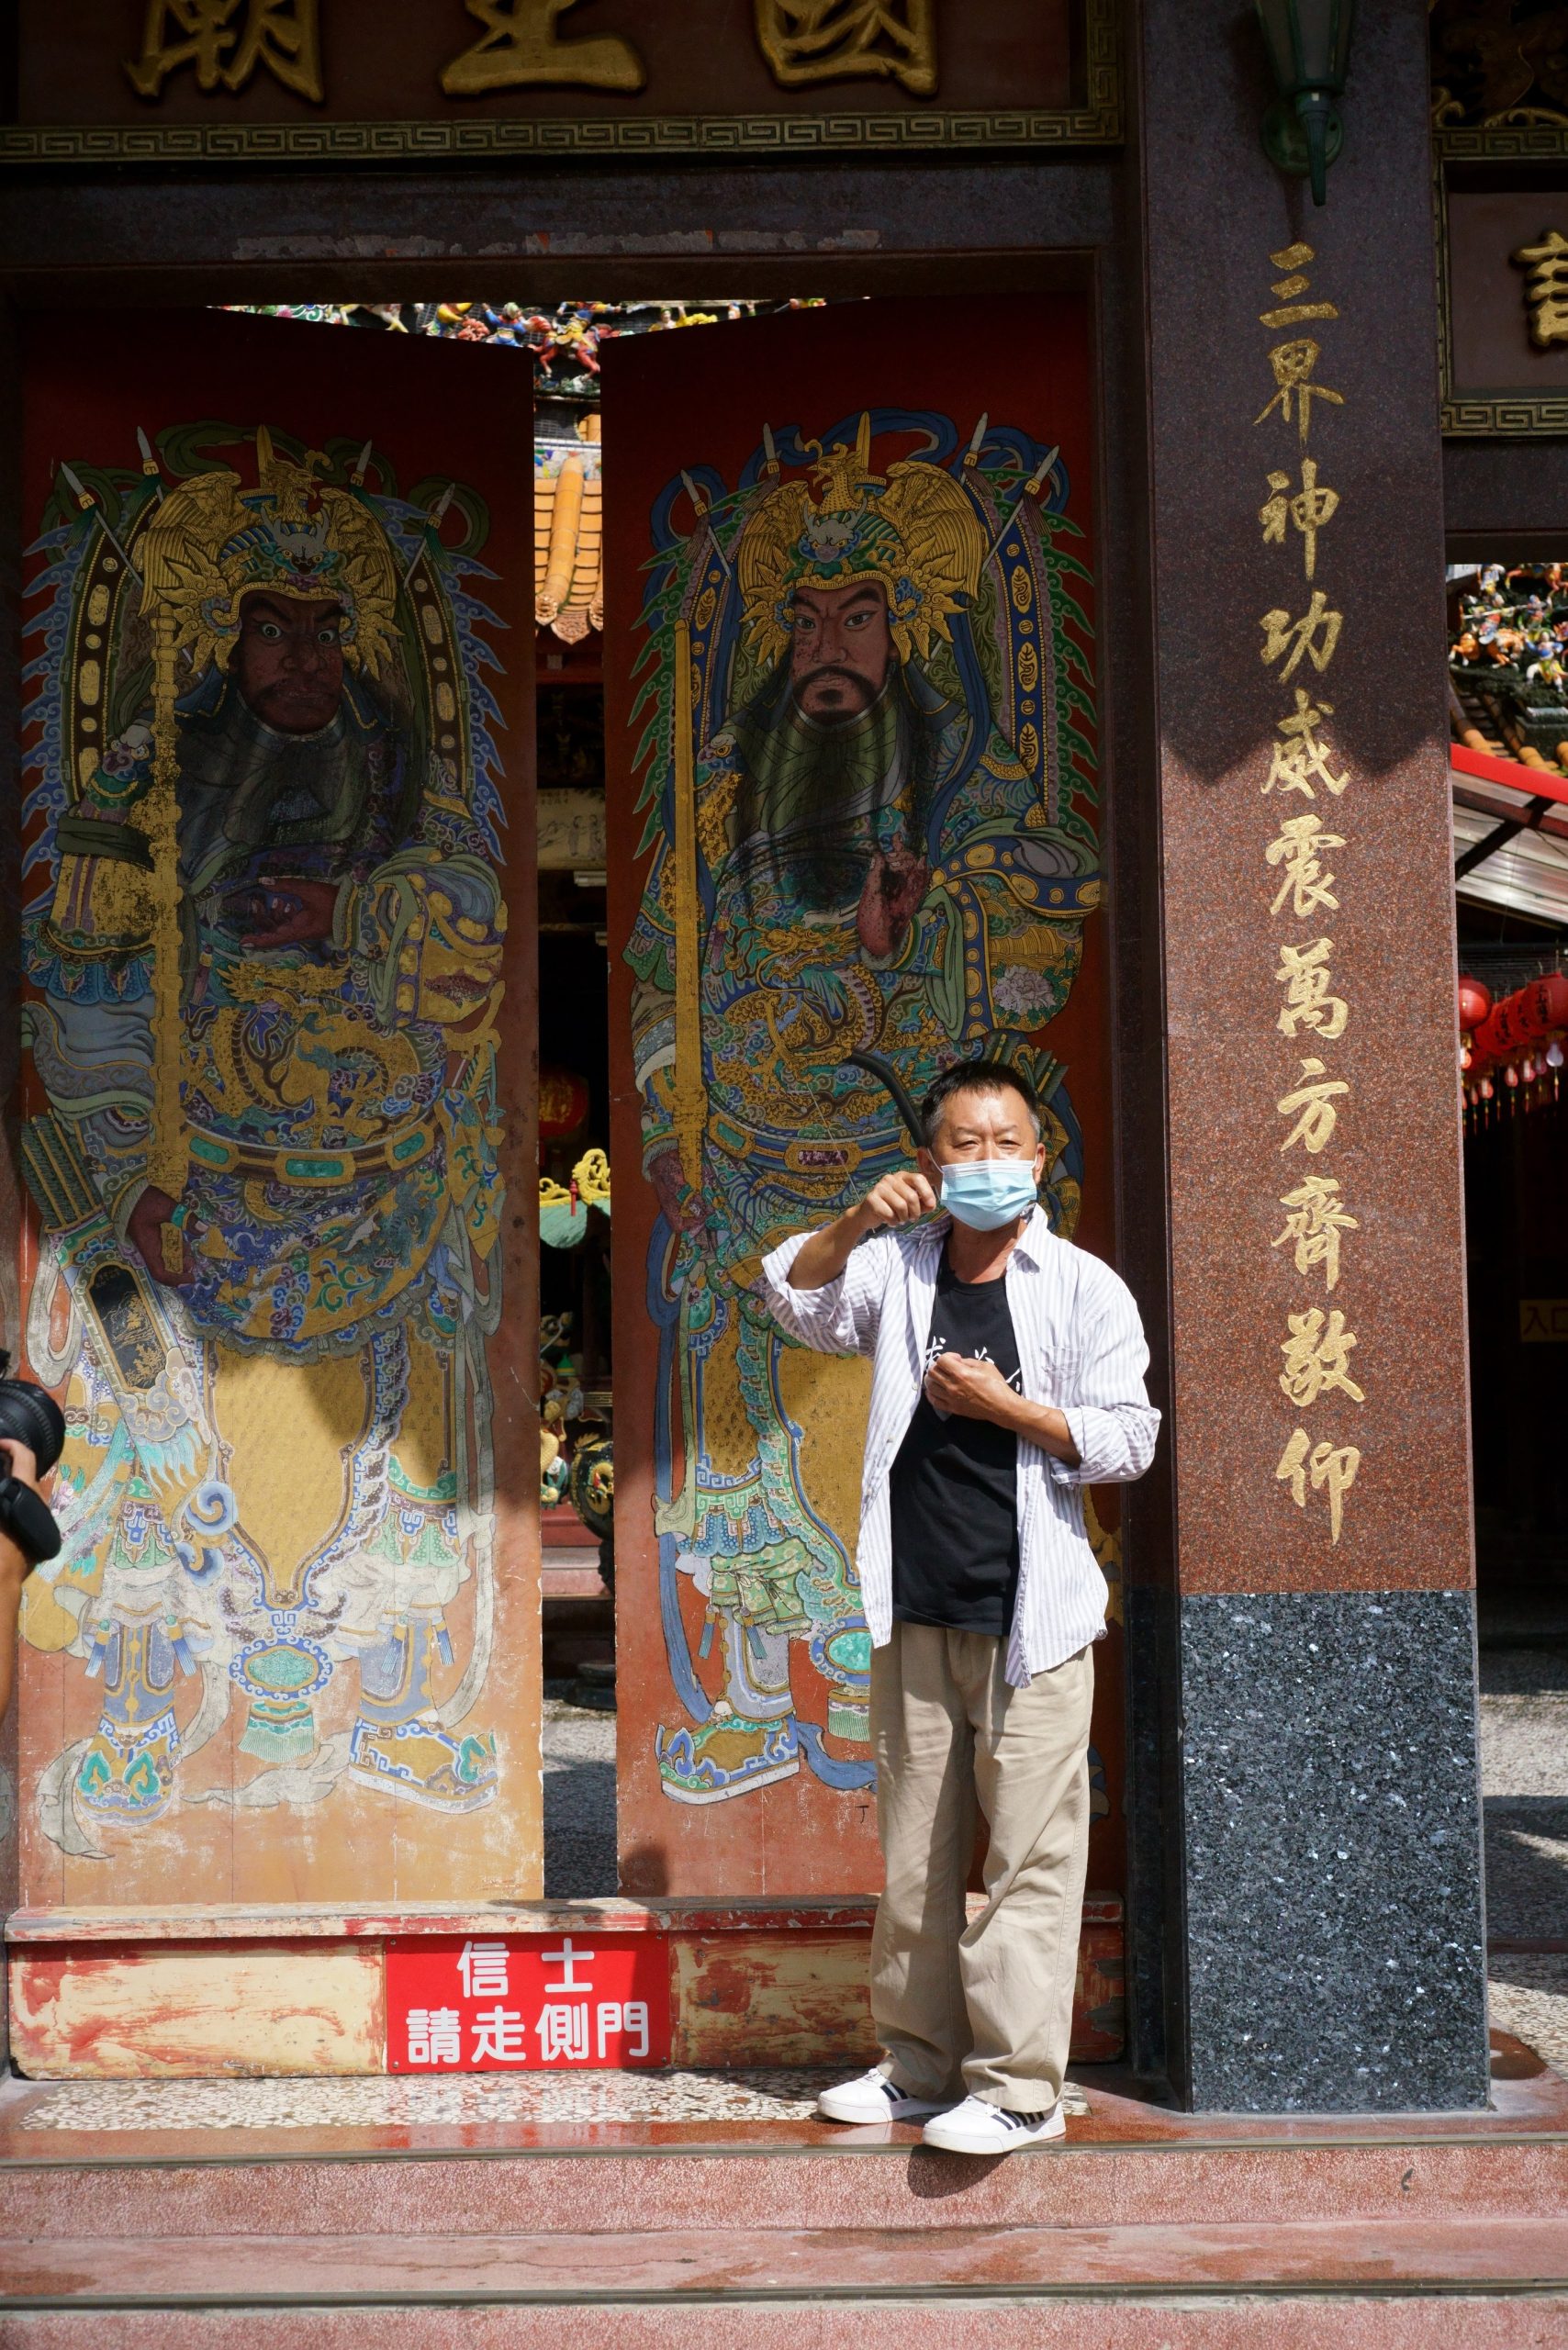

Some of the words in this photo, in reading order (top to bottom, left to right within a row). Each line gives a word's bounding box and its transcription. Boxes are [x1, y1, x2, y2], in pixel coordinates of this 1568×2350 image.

[1253, 241, 1366, 1545] 三界神功威震萬方齊敬仰
[406, 2001, 649, 2064] 請走側門
